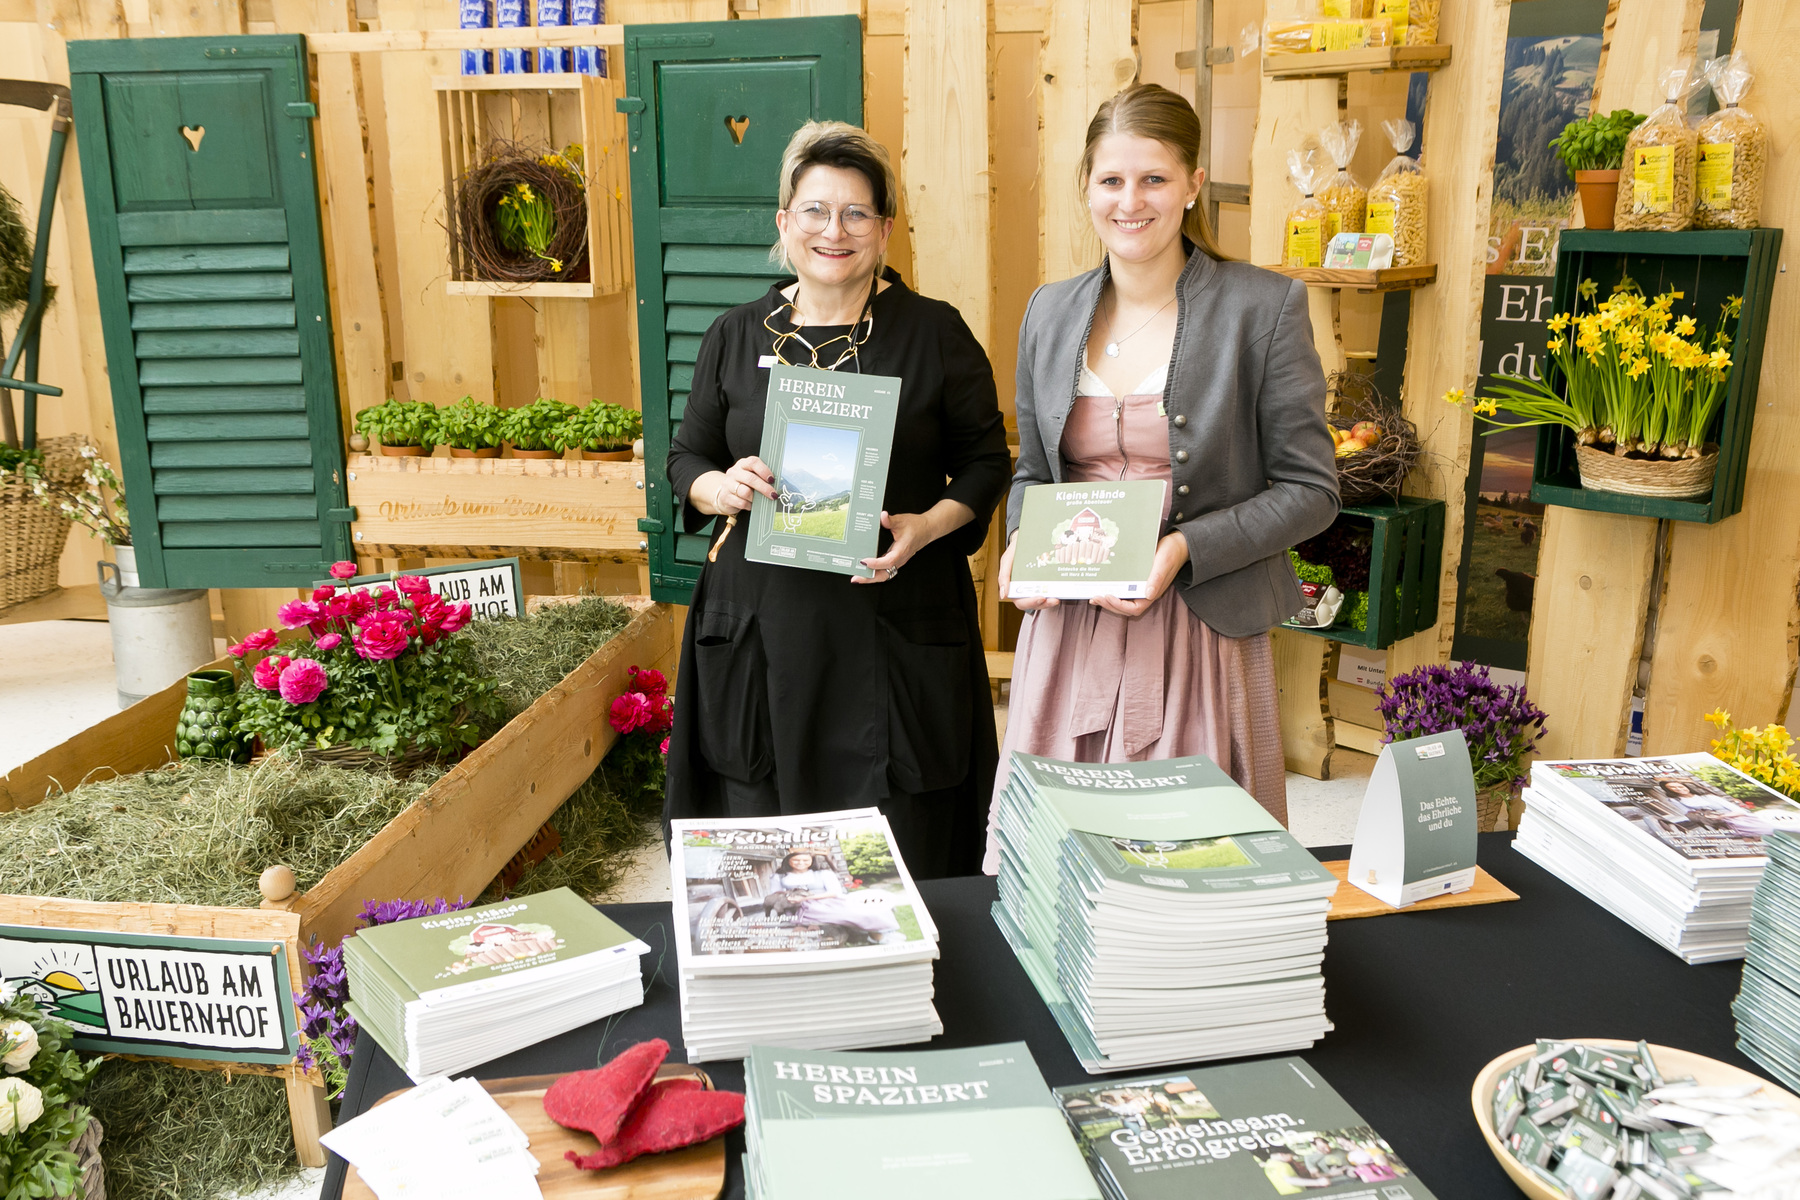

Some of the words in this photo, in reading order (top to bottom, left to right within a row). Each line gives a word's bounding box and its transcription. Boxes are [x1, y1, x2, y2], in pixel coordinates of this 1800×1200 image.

[778, 378, 846, 399] HEREIN
[792, 397, 873, 419] SPAZIERT
[1056, 491, 1088, 500] Kleine
[1091, 489, 1126, 499] Hände
[480, 574, 505, 597] AM
[1031, 760, 1134, 781] HEREIN
[1063, 774, 1187, 791] SPAZIERT
[1418, 813, 1431, 823] das
[1431, 805, 1462, 820] Ehrliche
[1420, 801, 1434, 811] Das
[1435, 796, 1458, 808] Echte,
[1428, 819, 1442, 831] und
[1443, 818, 1453, 828] du
[421, 915, 474, 930] Kleine
[476, 904, 528, 919] Hände
[473, 912, 515, 925] Abenteuer
[107, 958, 209, 996] URLAUB
[222, 964, 263, 998] AM
[113, 996, 269, 1038] BAUERNHOF
[773, 1060, 918, 1085] HEREIN
[814, 1080, 989, 1106] SPAZIERT
[1110, 1111, 1305, 1150] Gemeinsam.
[1118, 1126, 1315, 1166] Erfolgreich.
